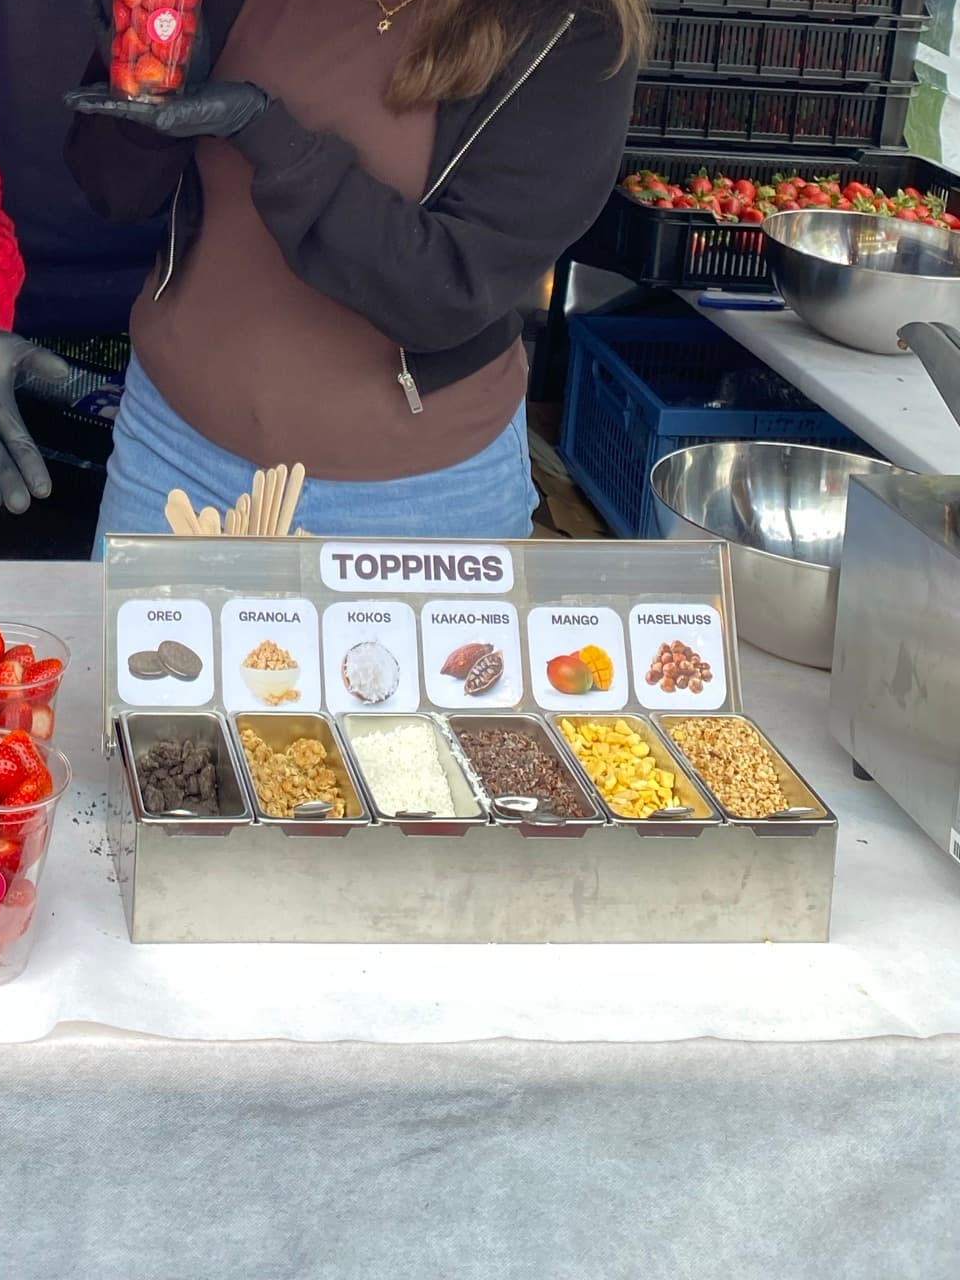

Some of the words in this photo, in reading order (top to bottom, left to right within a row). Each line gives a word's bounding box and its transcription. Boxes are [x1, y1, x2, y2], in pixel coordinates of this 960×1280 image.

[332, 553, 504, 582] TOPPINGS
[147, 610, 182, 622] OREO
[238, 611, 301, 623] GRANOLA
[347, 612, 392, 623] KOKOS
[431, 613, 510, 625] KAKAO-NIBS
[551, 614, 599, 626] MANGO
[637, 614, 712, 625] HASELNUSS
